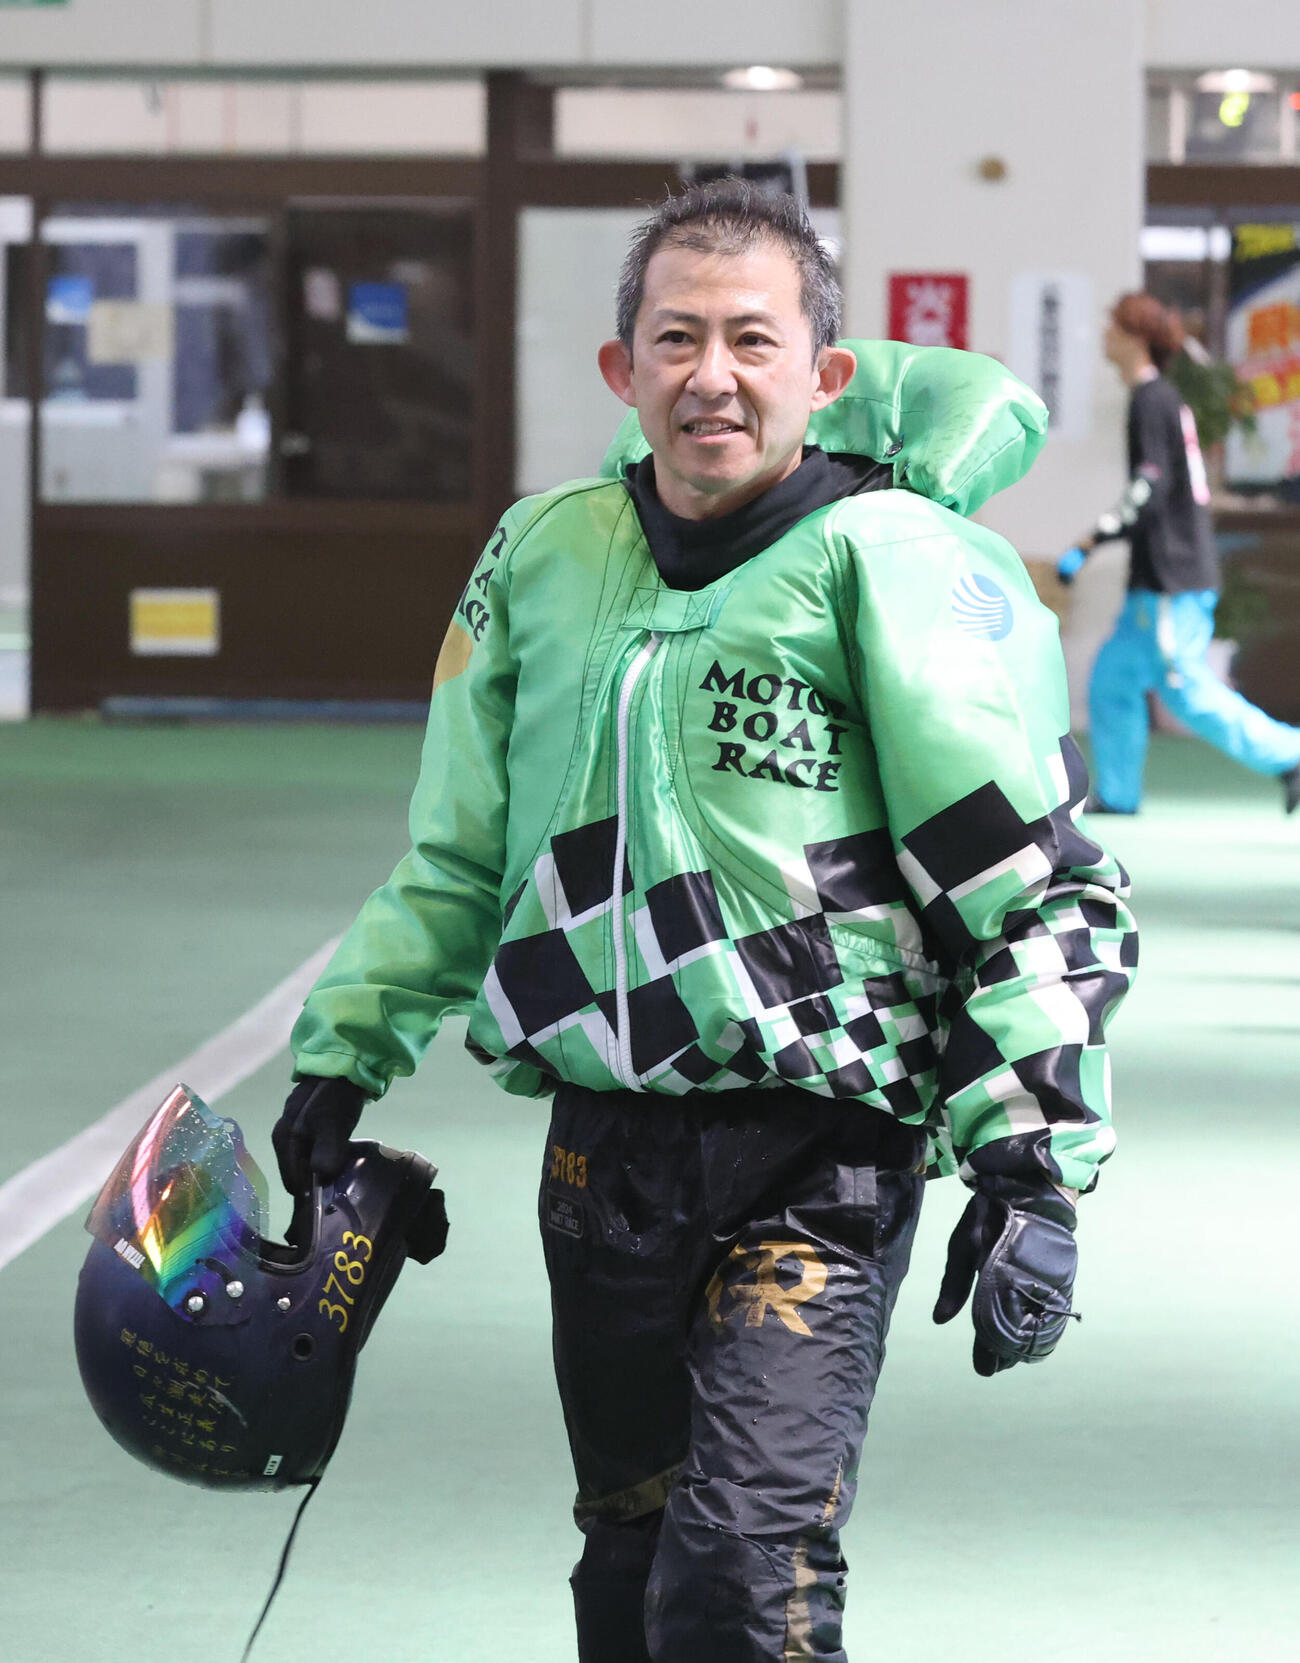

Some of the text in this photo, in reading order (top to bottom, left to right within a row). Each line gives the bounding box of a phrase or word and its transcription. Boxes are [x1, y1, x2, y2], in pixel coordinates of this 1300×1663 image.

[707, 701, 850, 756] BOAT
[711, 742, 842, 792] RACE
[551, 1144, 588, 1188] 3783
[318, 1230, 373, 1334] 3783
